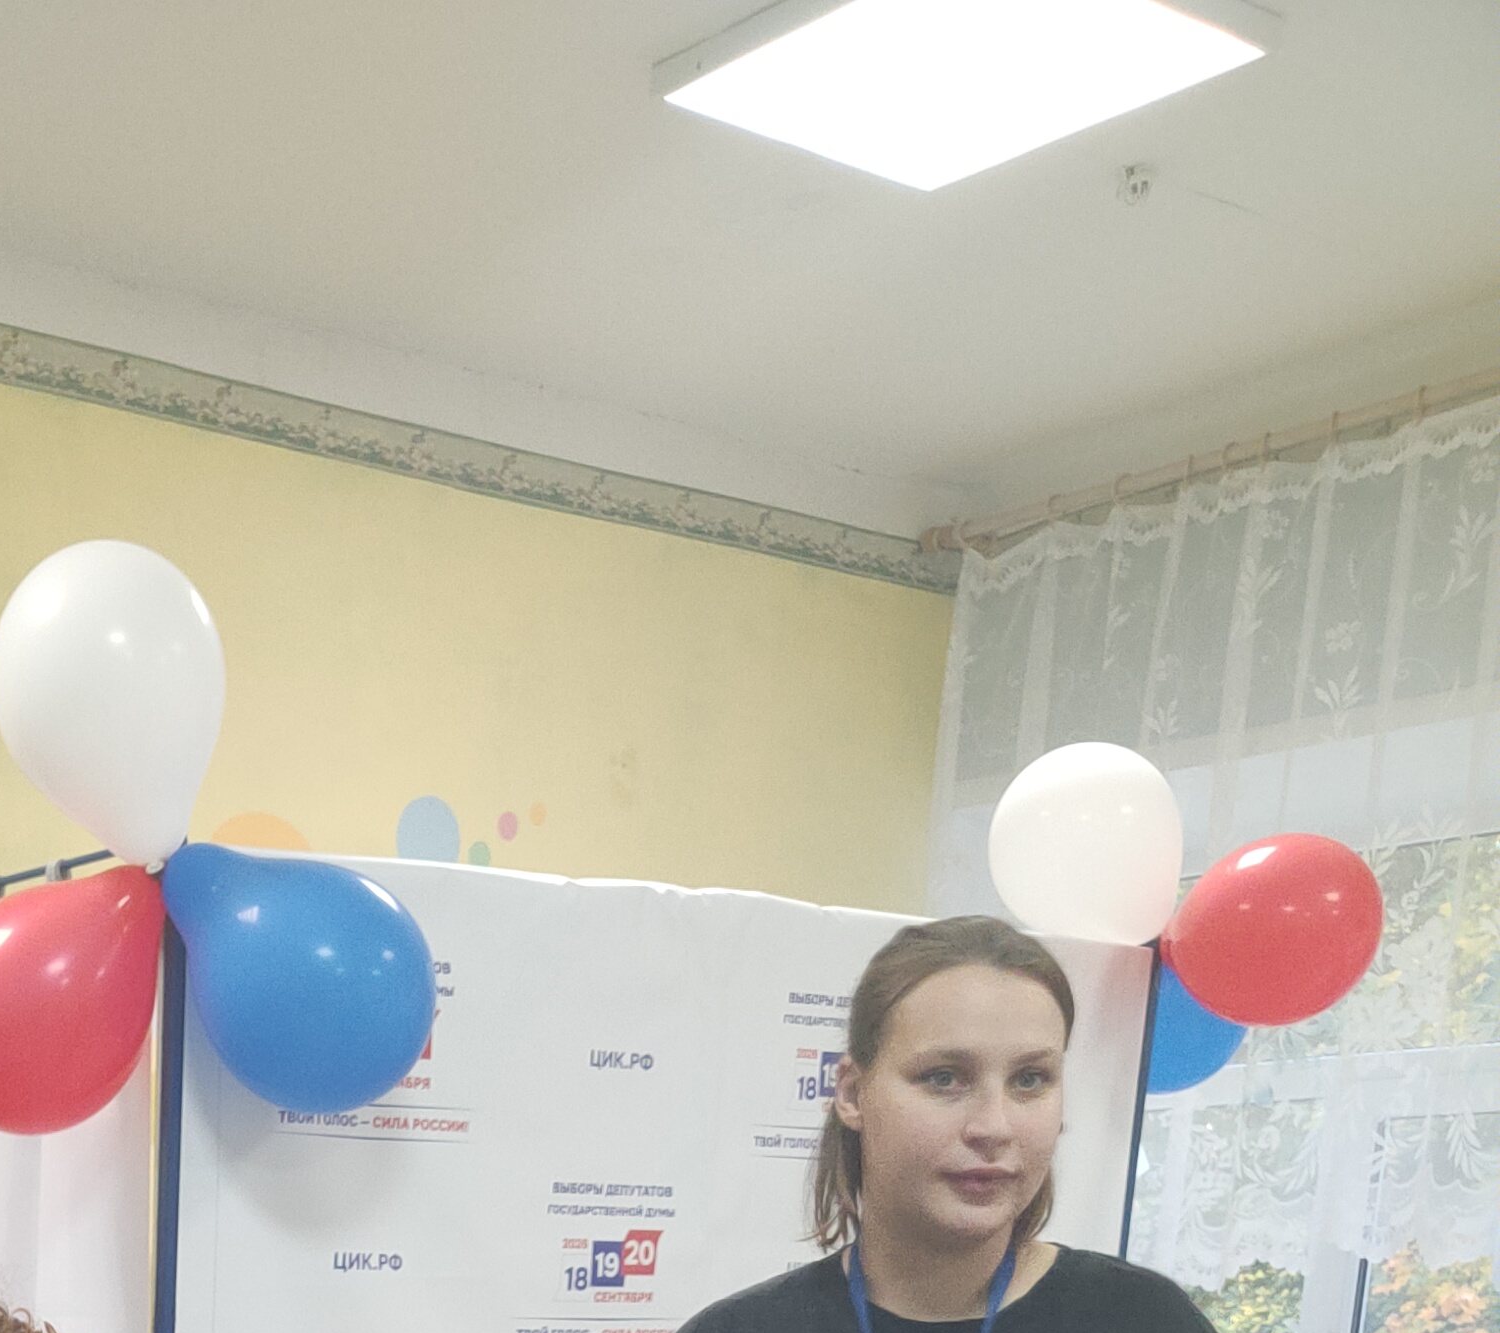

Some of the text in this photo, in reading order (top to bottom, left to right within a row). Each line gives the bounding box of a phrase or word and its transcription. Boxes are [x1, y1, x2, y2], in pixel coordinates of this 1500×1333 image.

[590, 1049, 654, 1071] ЦИК.РФ
[797, 1076, 817, 1101] 18
[372, 1116, 409, 1130] СИЛА
[754, 1134, 781, 1148] ТВОЙ
[552, 1182, 673, 1197] ВЫБОРЫ ДЕПУТАТОВ
[333, 1252, 403, 1272] ЦИК.РФ
[565, 1239, 655, 1291] 18 19 20
